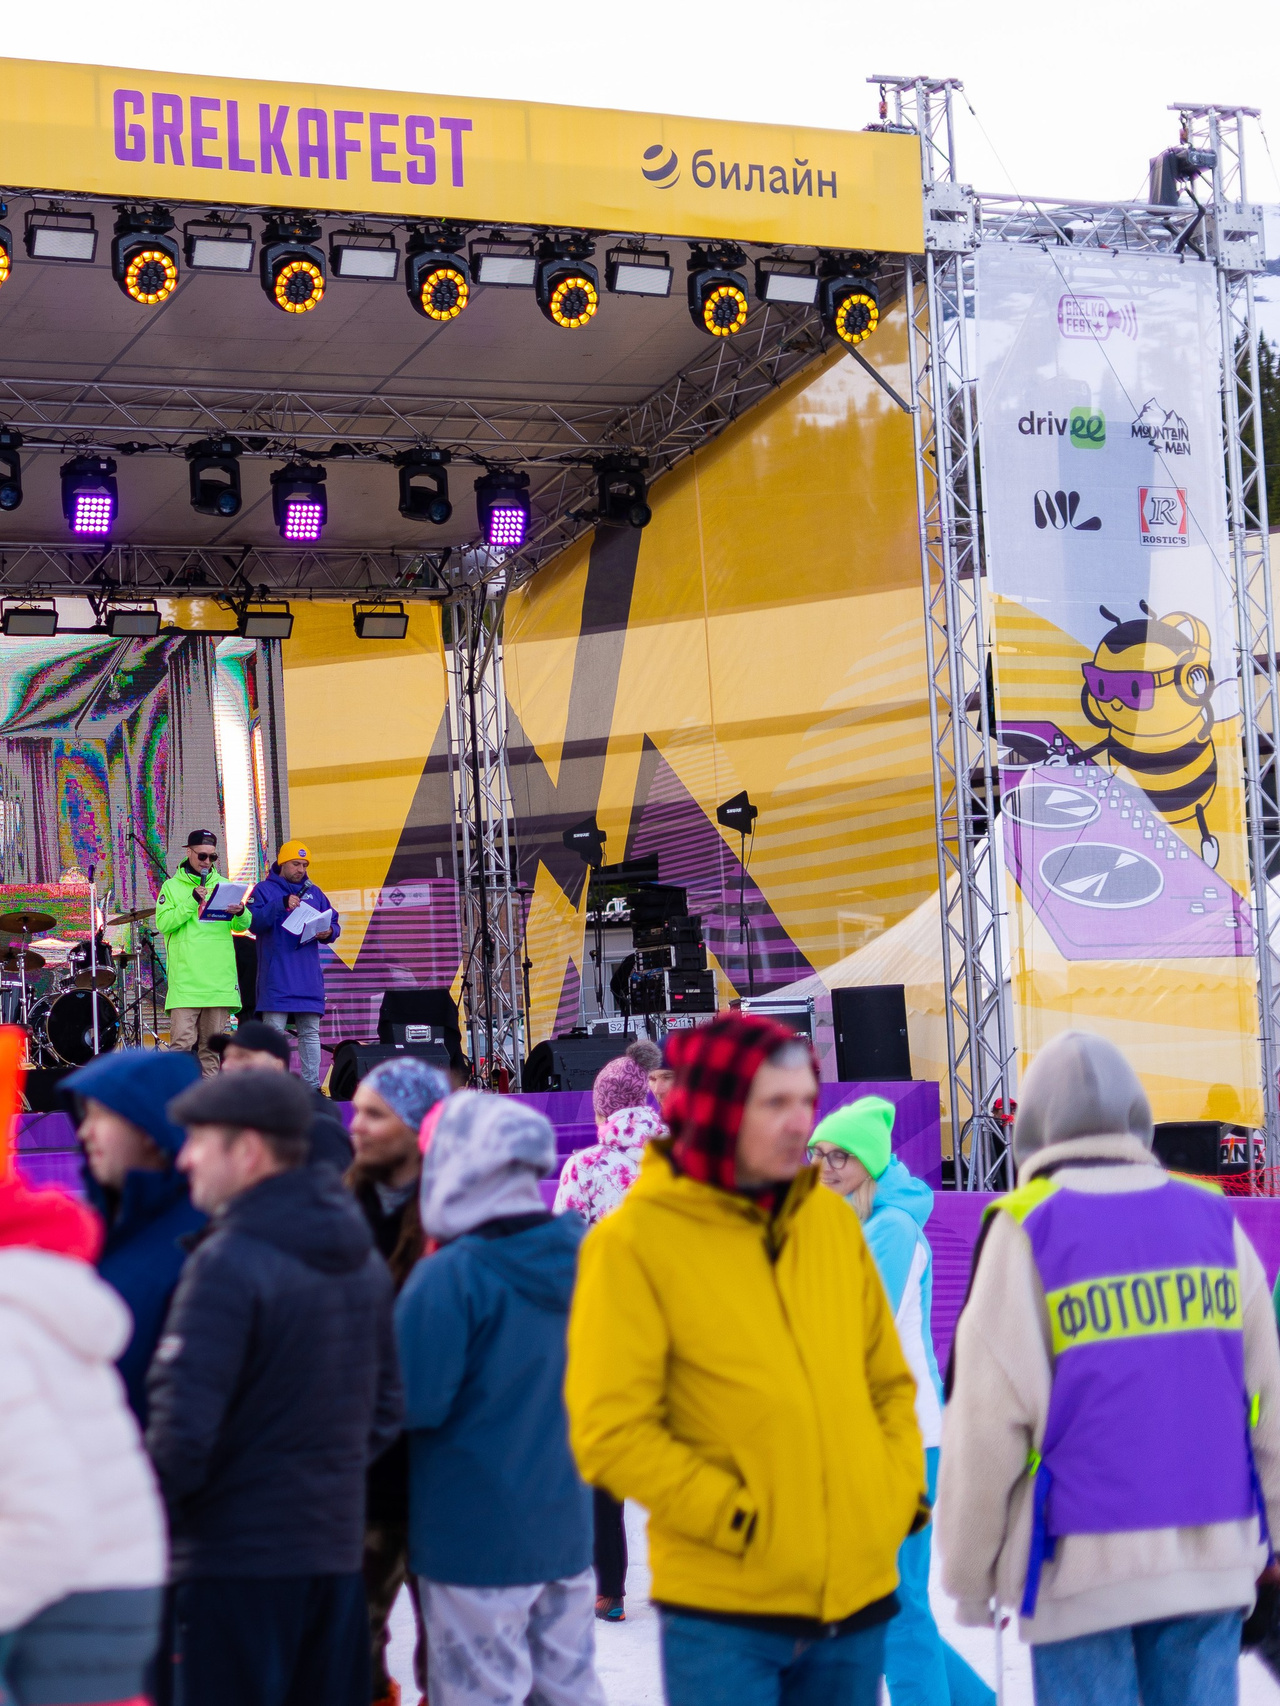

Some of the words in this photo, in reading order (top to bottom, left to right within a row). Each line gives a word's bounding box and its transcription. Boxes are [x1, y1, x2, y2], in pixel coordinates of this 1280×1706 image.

[113, 88, 473, 188] GRELKAFEST
[692, 149, 837, 198] билайн
[1065, 301, 1104, 317] GRELKA
[1066, 318, 1091, 333] FEST
[1018, 411, 1106, 442] drivee
[1131, 424, 1189, 442] MOUNTAIN
[1165, 441, 1191, 456] MAN
[1149, 497, 1178, 525] R
[1142, 535, 1187, 544] ROSTIC'S
[610, 1022, 633, 1032] S21
[1057, 1271, 1237, 1339] ФОТОГРАФ
